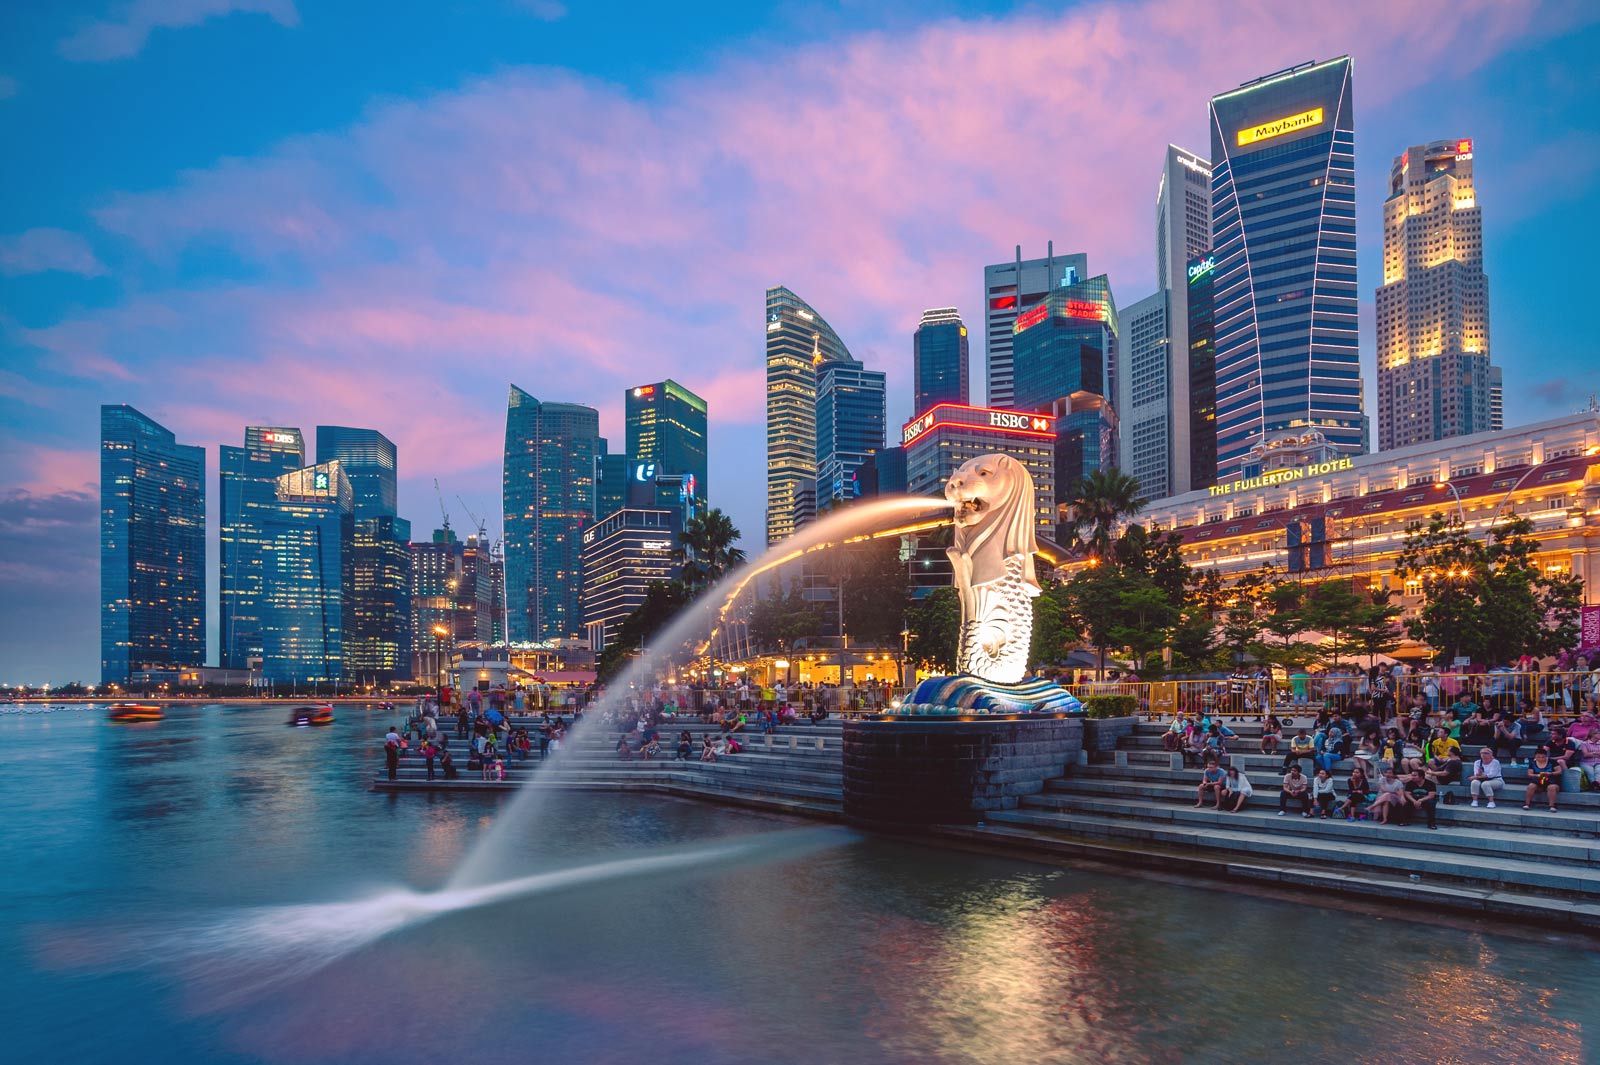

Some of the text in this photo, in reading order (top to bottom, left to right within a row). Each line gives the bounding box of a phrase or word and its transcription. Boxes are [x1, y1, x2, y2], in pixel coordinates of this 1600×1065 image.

[1255, 114, 1315, 138] Maybank
[1455, 153, 1473, 162] UOB
[903, 419, 924, 443] HSBC
[990, 412, 1029, 430] HSBC
[274, 433, 295, 444] DBS
[1208, 458, 1354, 497] THE FULLERTON HOTEL
